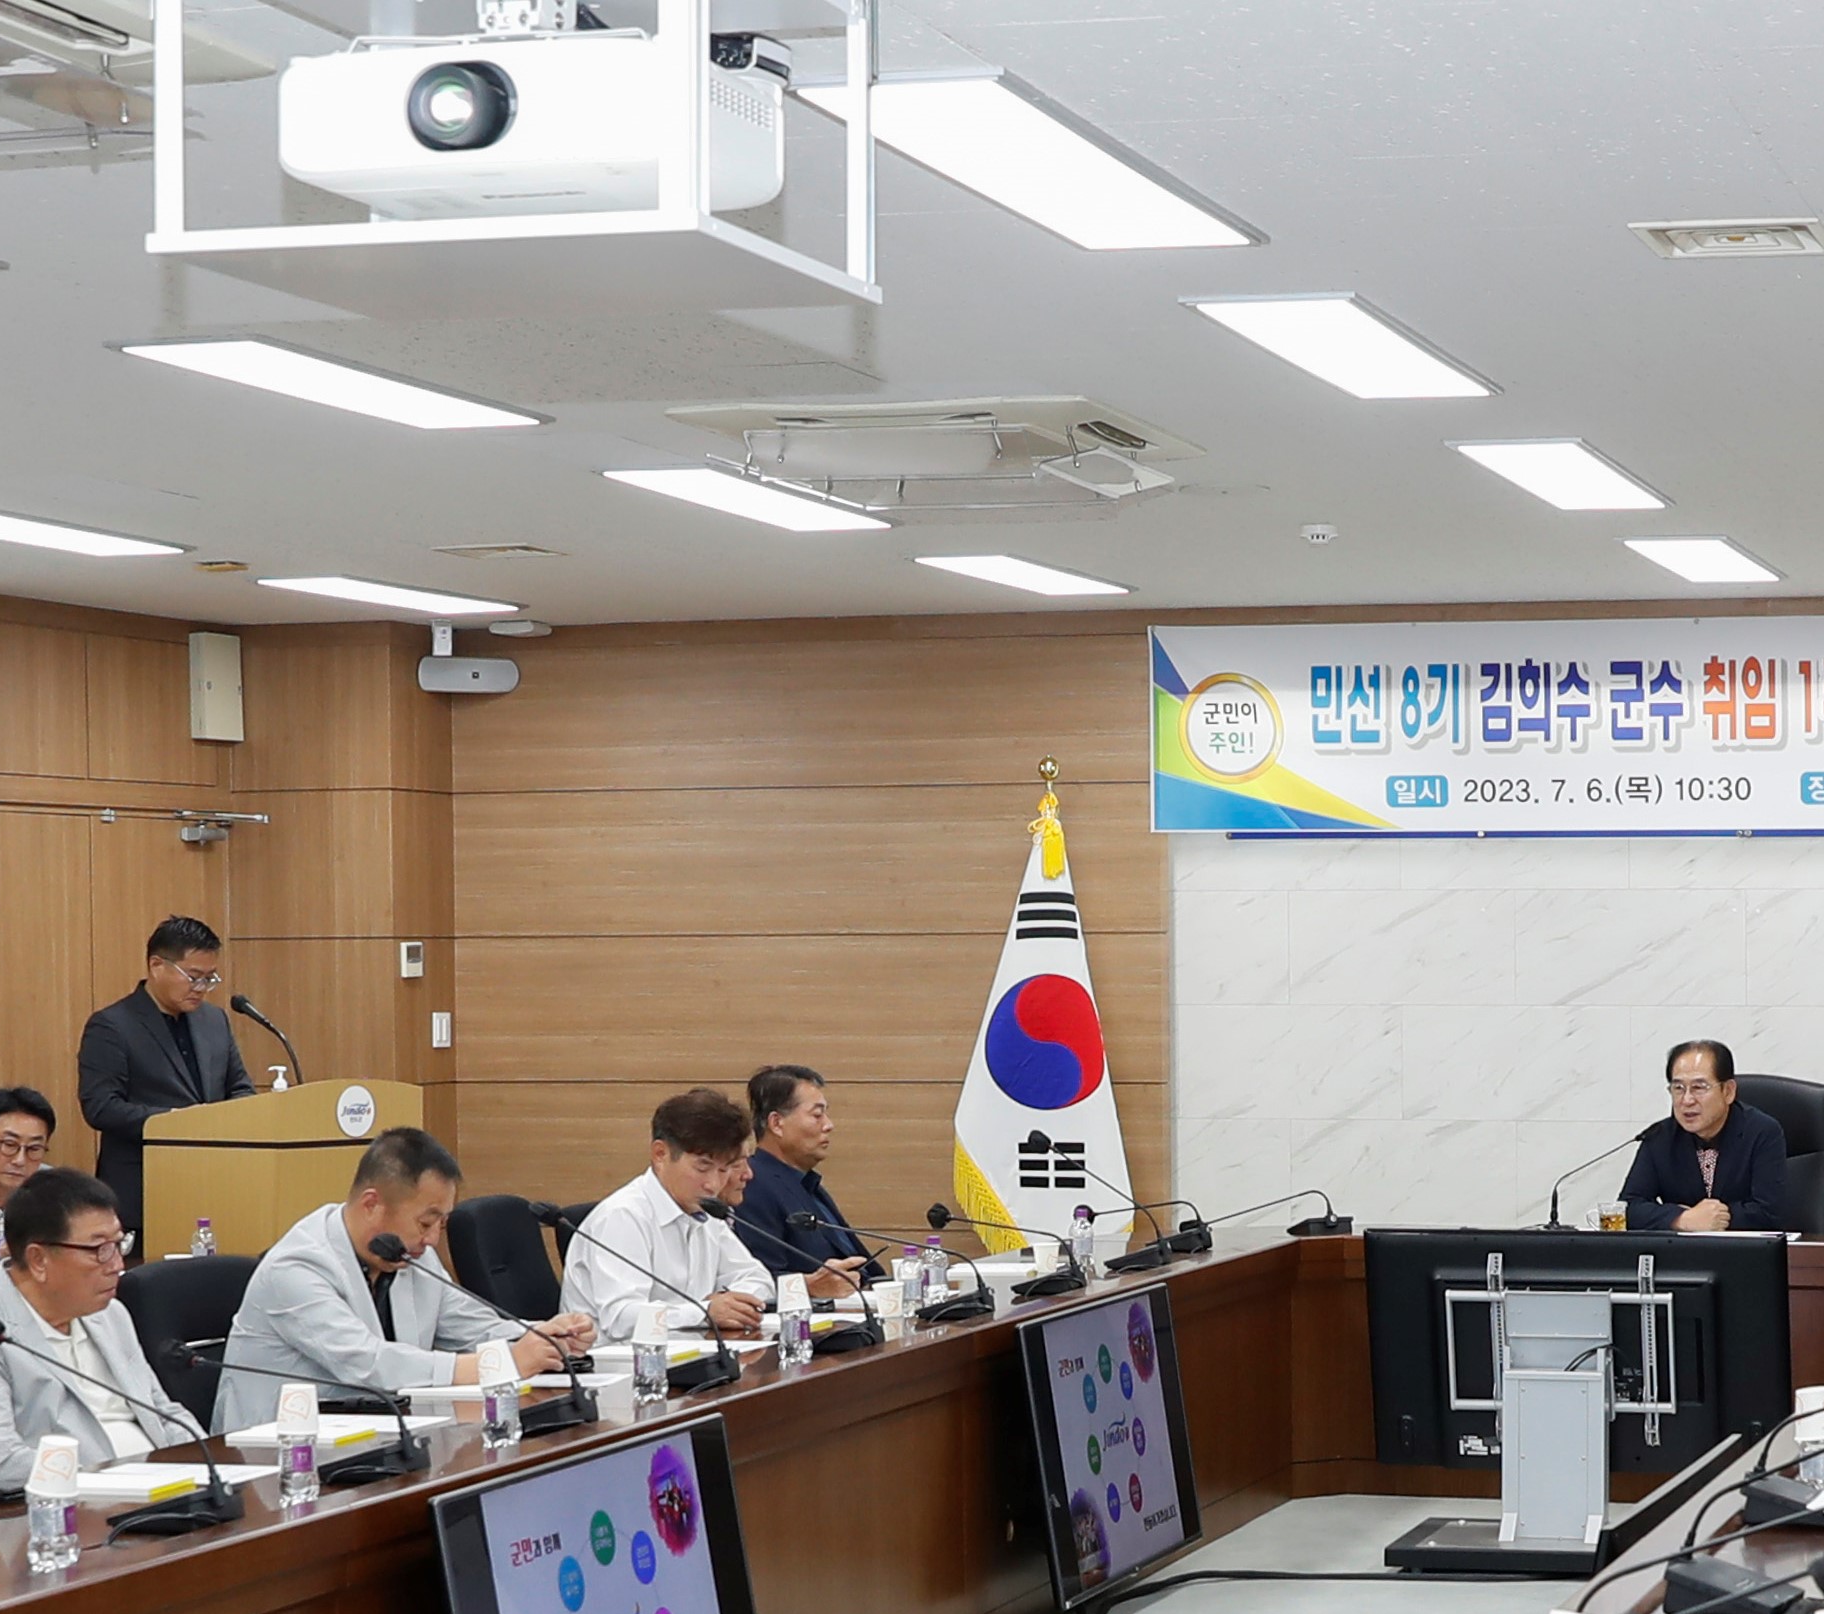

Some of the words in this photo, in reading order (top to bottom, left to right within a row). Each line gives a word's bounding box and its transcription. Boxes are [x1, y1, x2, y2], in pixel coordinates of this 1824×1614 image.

[1310, 663, 1381, 744] 민선
[1401, 663, 1460, 744] 8기
[1479, 659, 1592, 744] 김희수
[1609, 659, 1685, 743] 군수
[1702, 656, 1776, 741] 취임
[1203, 702, 1258, 725] 군민이
[1209, 732, 1254, 754] 주인!
[1393, 780, 1442, 804] 일시
[1463, 781, 1540, 803] 2023.
[1552, 780, 1575, 803] 7.
[1587, 775, 1663, 805] 6.(목)
[1675, 778, 1751, 801] 10:30
